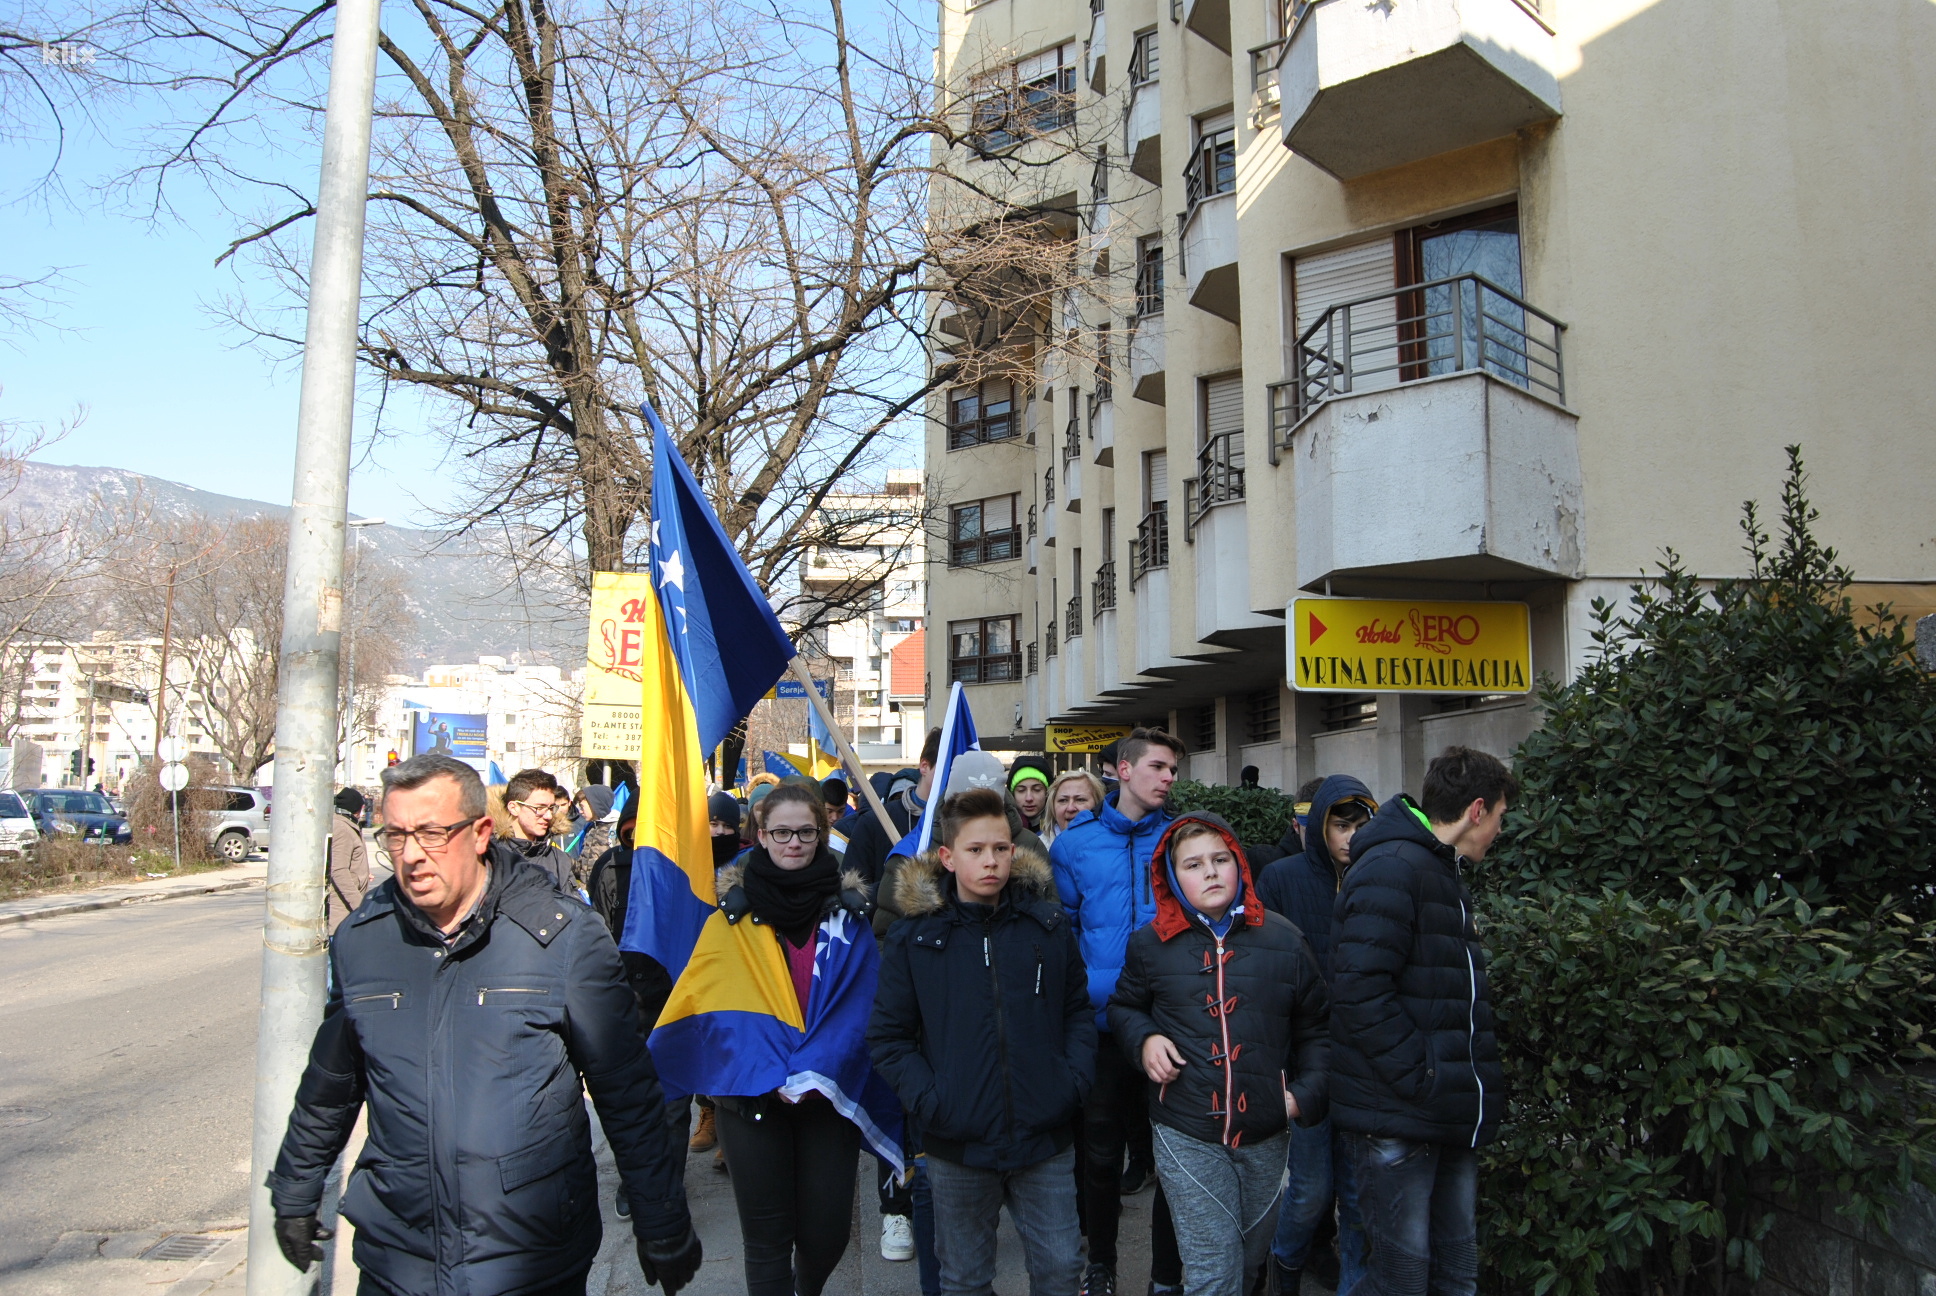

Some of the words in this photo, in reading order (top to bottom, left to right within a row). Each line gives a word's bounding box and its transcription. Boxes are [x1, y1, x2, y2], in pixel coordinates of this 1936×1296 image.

[1355, 618, 1404, 645] Hotel
[1300, 656, 1368, 685] VRTNA
[1376, 657, 1525, 688] RESTAURACIJA
[780, 686, 805, 695] Saraje
[611, 711, 640, 719] 88000
[603, 722, 627, 730] ANTE
[593, 732, 609, 740] Tel:
[592, 742, 610, 751] Fax:
